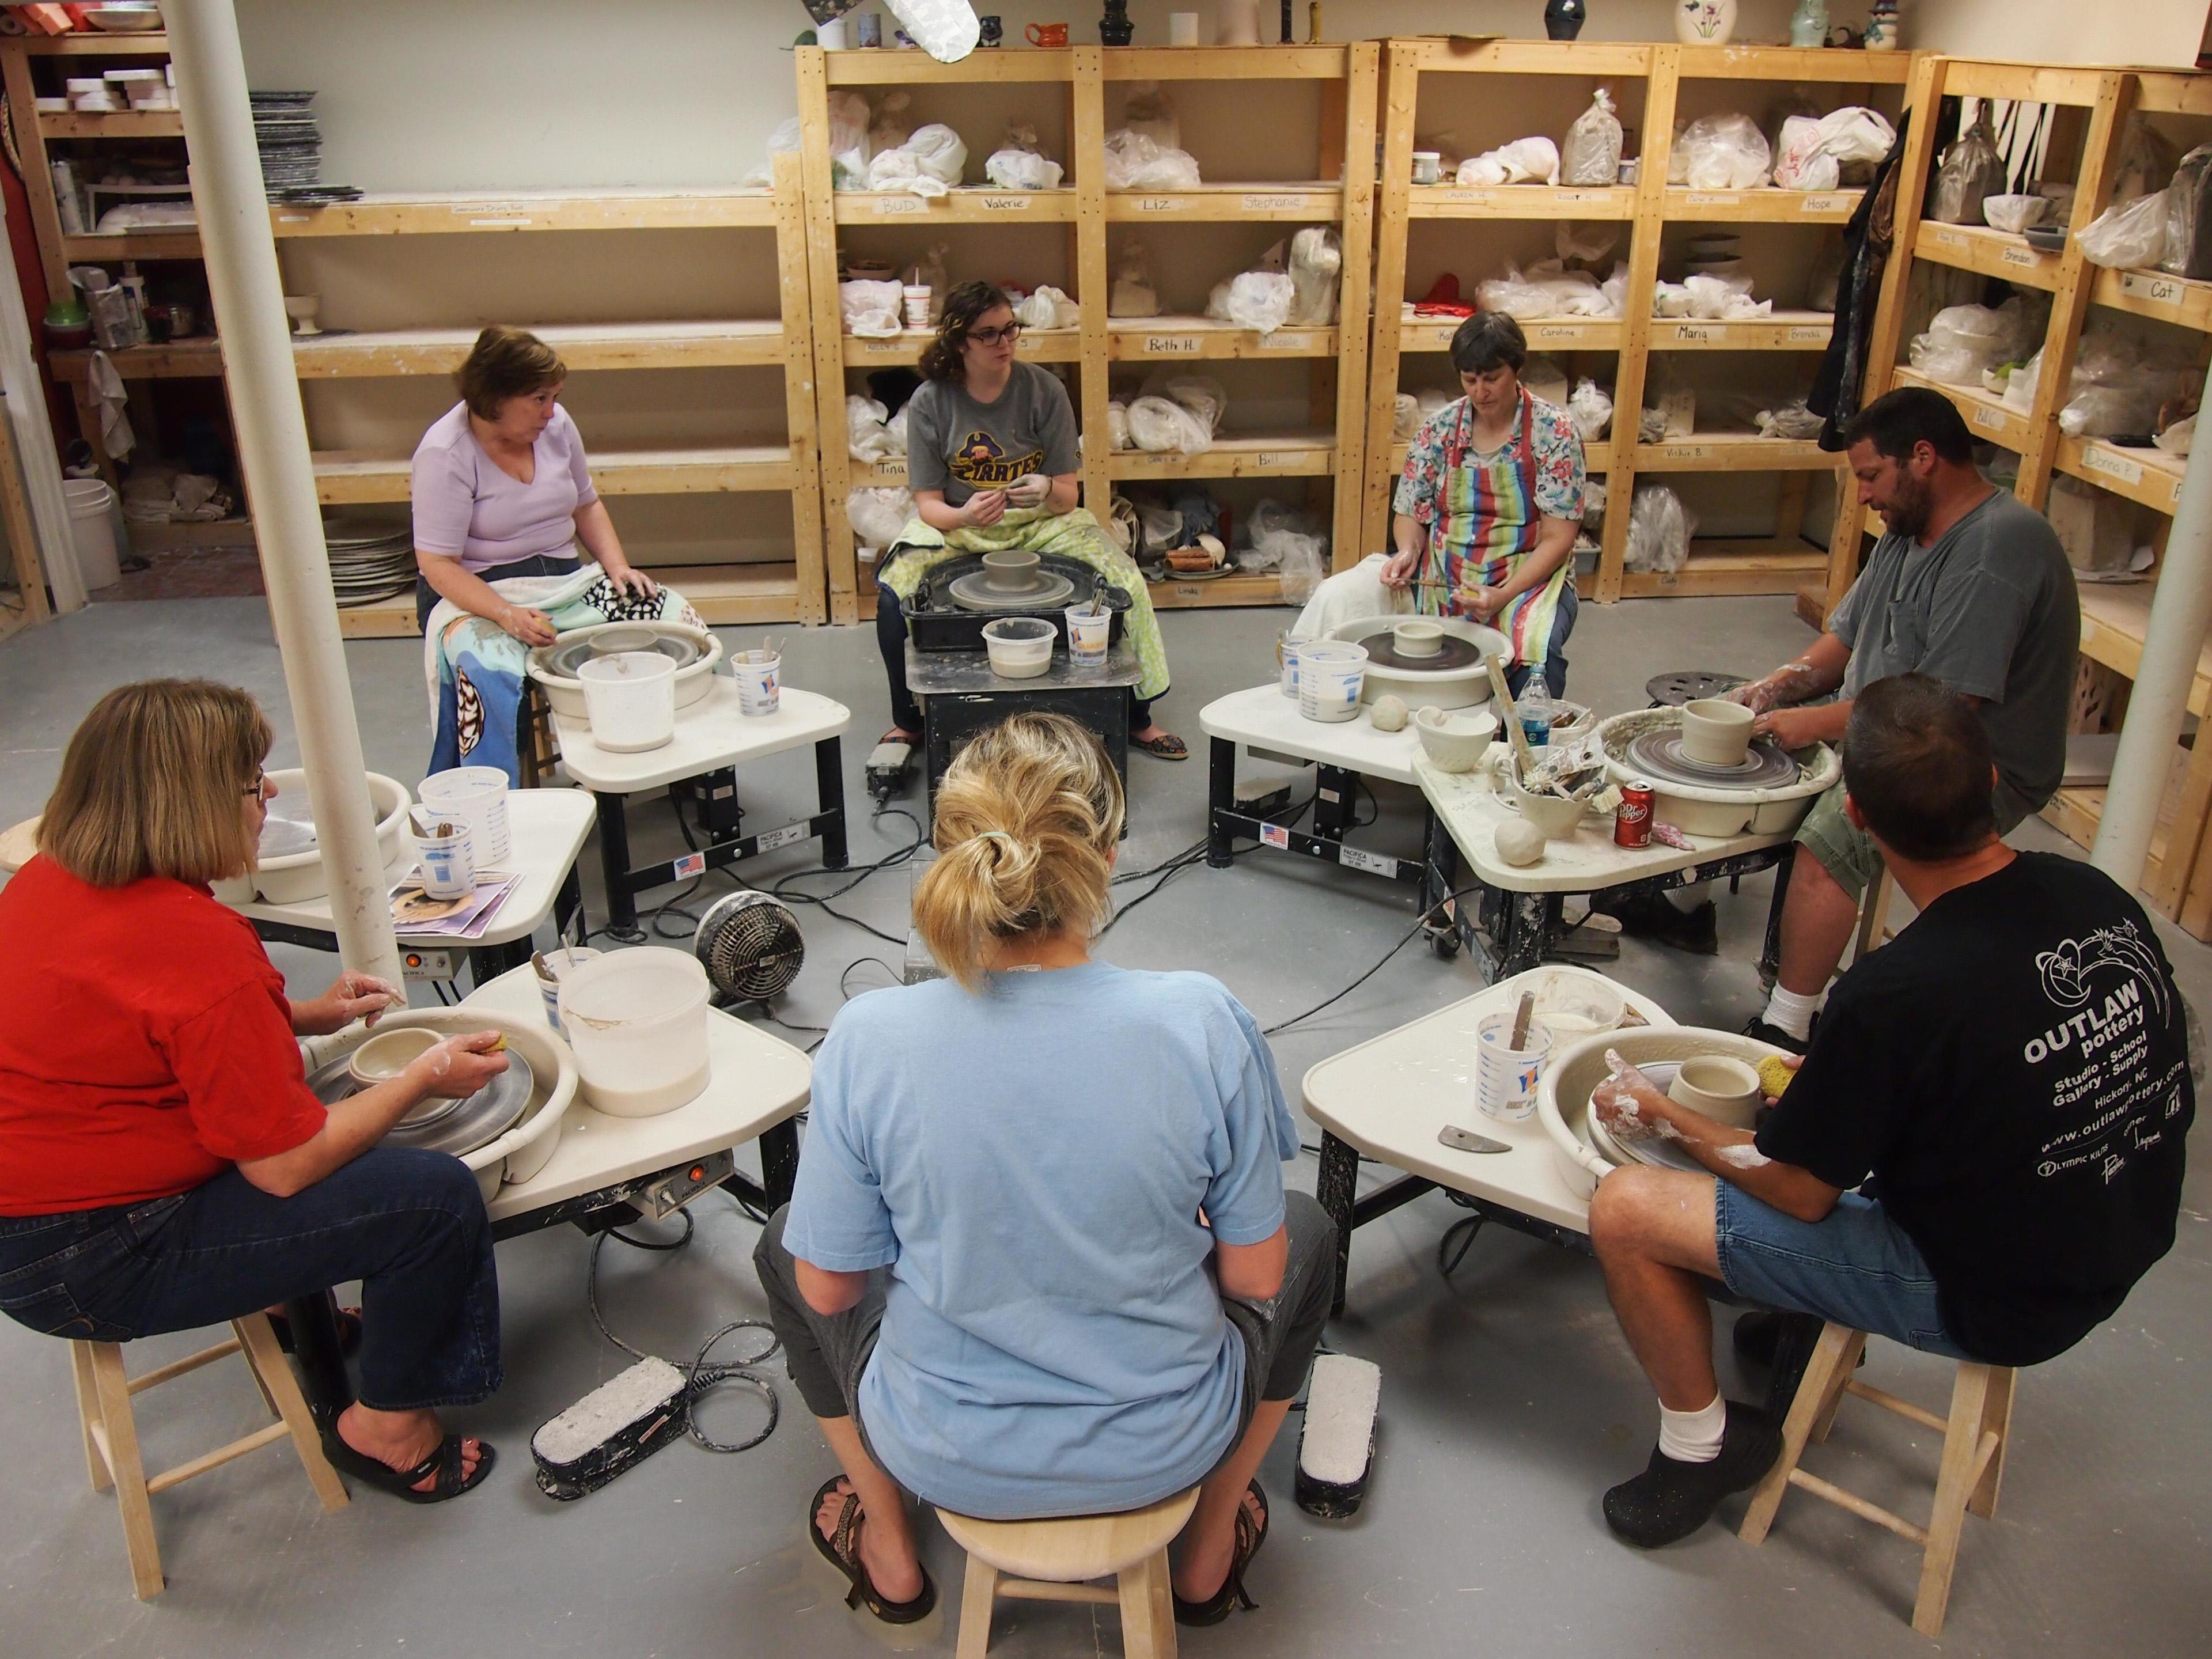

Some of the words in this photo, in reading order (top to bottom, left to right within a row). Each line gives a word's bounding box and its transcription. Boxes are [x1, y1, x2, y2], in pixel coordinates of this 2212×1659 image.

[883, 199, 916, 213] BUD
[984, 198, 1024, 209] Valerie
[1245, 195, 1301, 209] Stephanie
[1807, 198, 1831, 210] Hope
[2151, 281, 2173, 298] Cat
[1540, 327, 1575, 336] Caroline
[1677, 326, 1708, 339] Maria
[1149, 338, 1178, 351] Beth
[950, 450, 1043, 482] PIRATES
[1259, 453, 1278, 465] Bill
[2085, 448, 2120, 473] Donna
[877, 463, 906, 474] Tina
[1619, 804, 1645, 820] Pepper
[1626, 804, 1638, 812] Dr
[2024, 979, 2140, 1063] OUTLAW
[2081, 1005, 2143, 1059] pottery
[2054, 1064, 2099, 1093] Studio
[2110, 1030, 2147, 1062] School
[2053, 1075, 2101, 1107] Gallery
[2112, 1045, 2148, 1076] Supply
[2135, 1067, 2148, 1084] NC
[2041, 1061, 2184, 1153] www.outlawpottery.com
